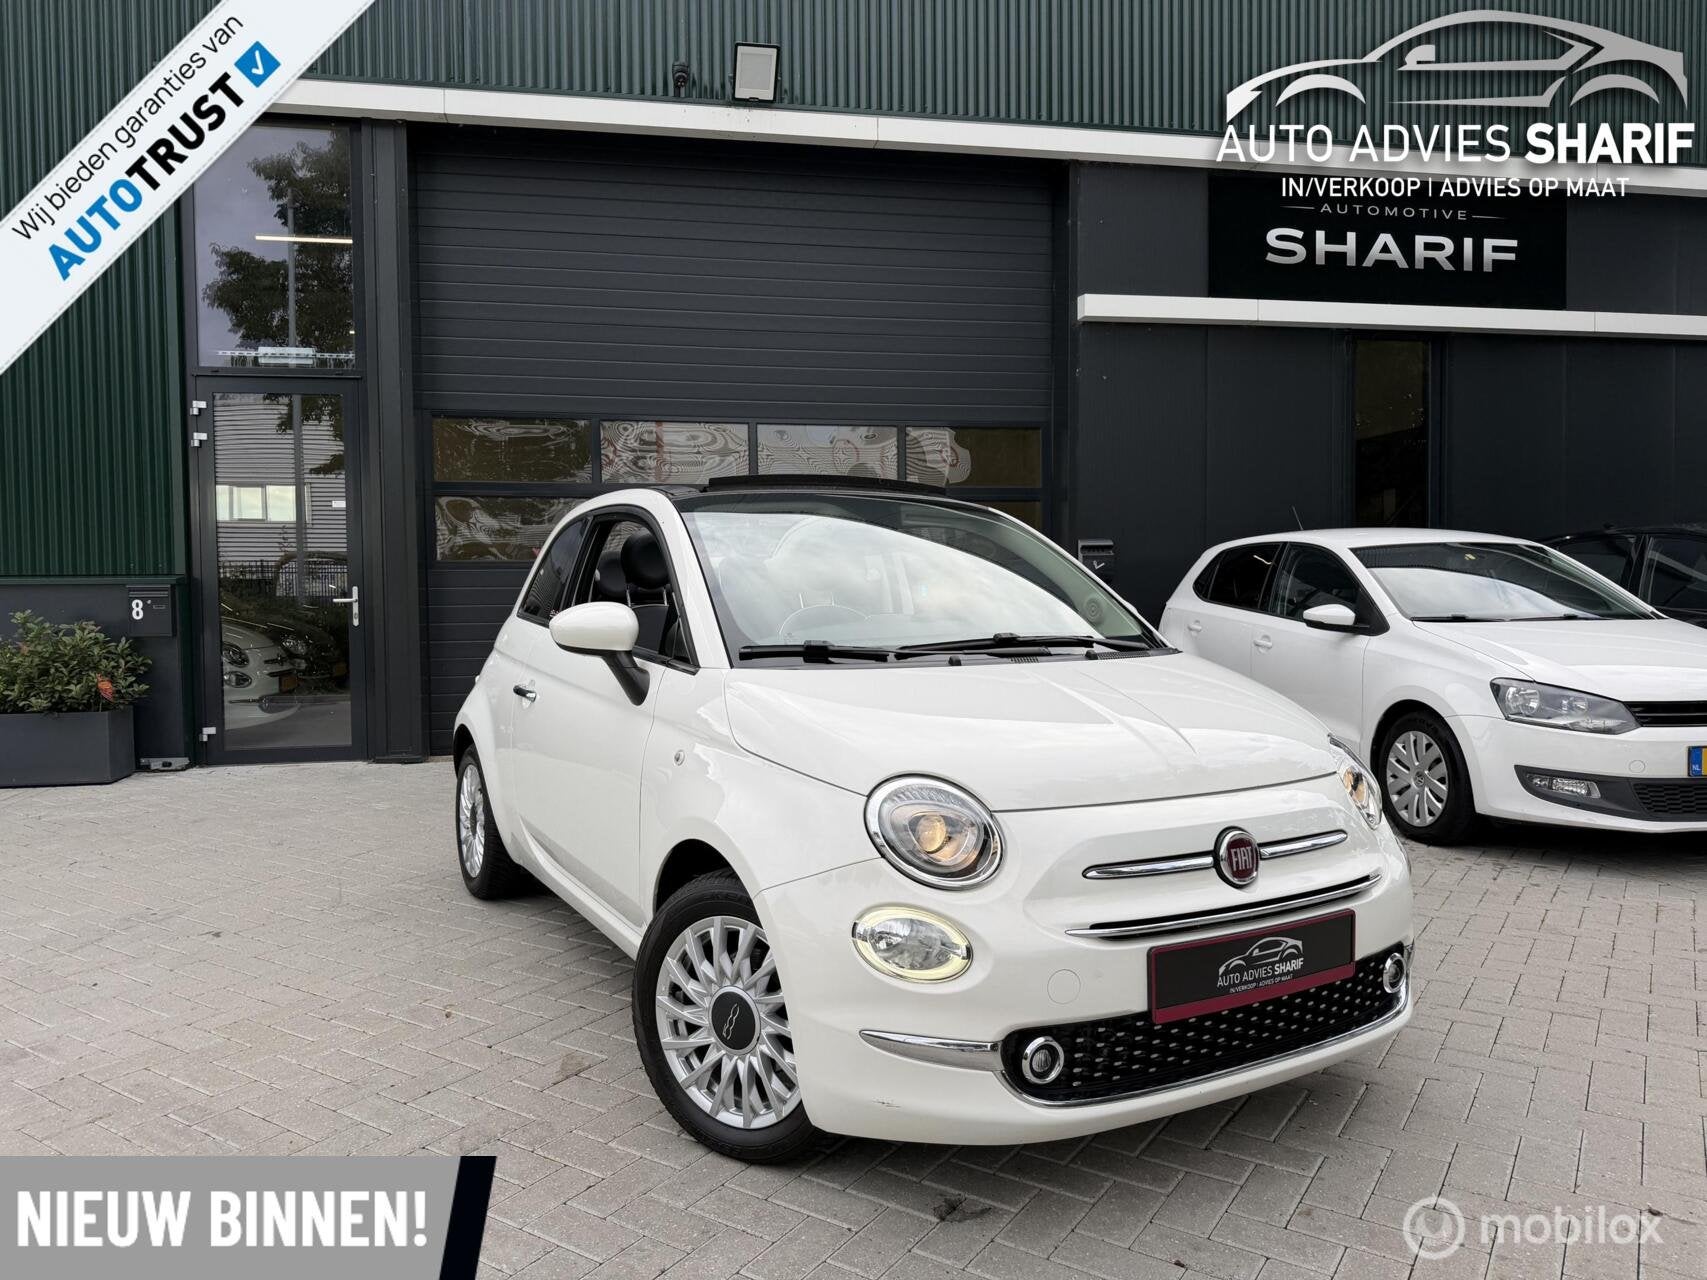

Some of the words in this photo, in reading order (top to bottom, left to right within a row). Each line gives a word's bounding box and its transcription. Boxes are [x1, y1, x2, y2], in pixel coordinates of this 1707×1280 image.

[1320, 203, 1468, 221] AUTOMOTIVE
[1264, 227, 1518, 272] SHARIF
[131, 599, 144, 620] 8
[1230, 846, 1254, 871] FIAT
[1217, 973, 1240, 987] AUTO
[1242, 966, 1273, 981] ADVIES
[1274, 958, 1304, 975] SHARIF
